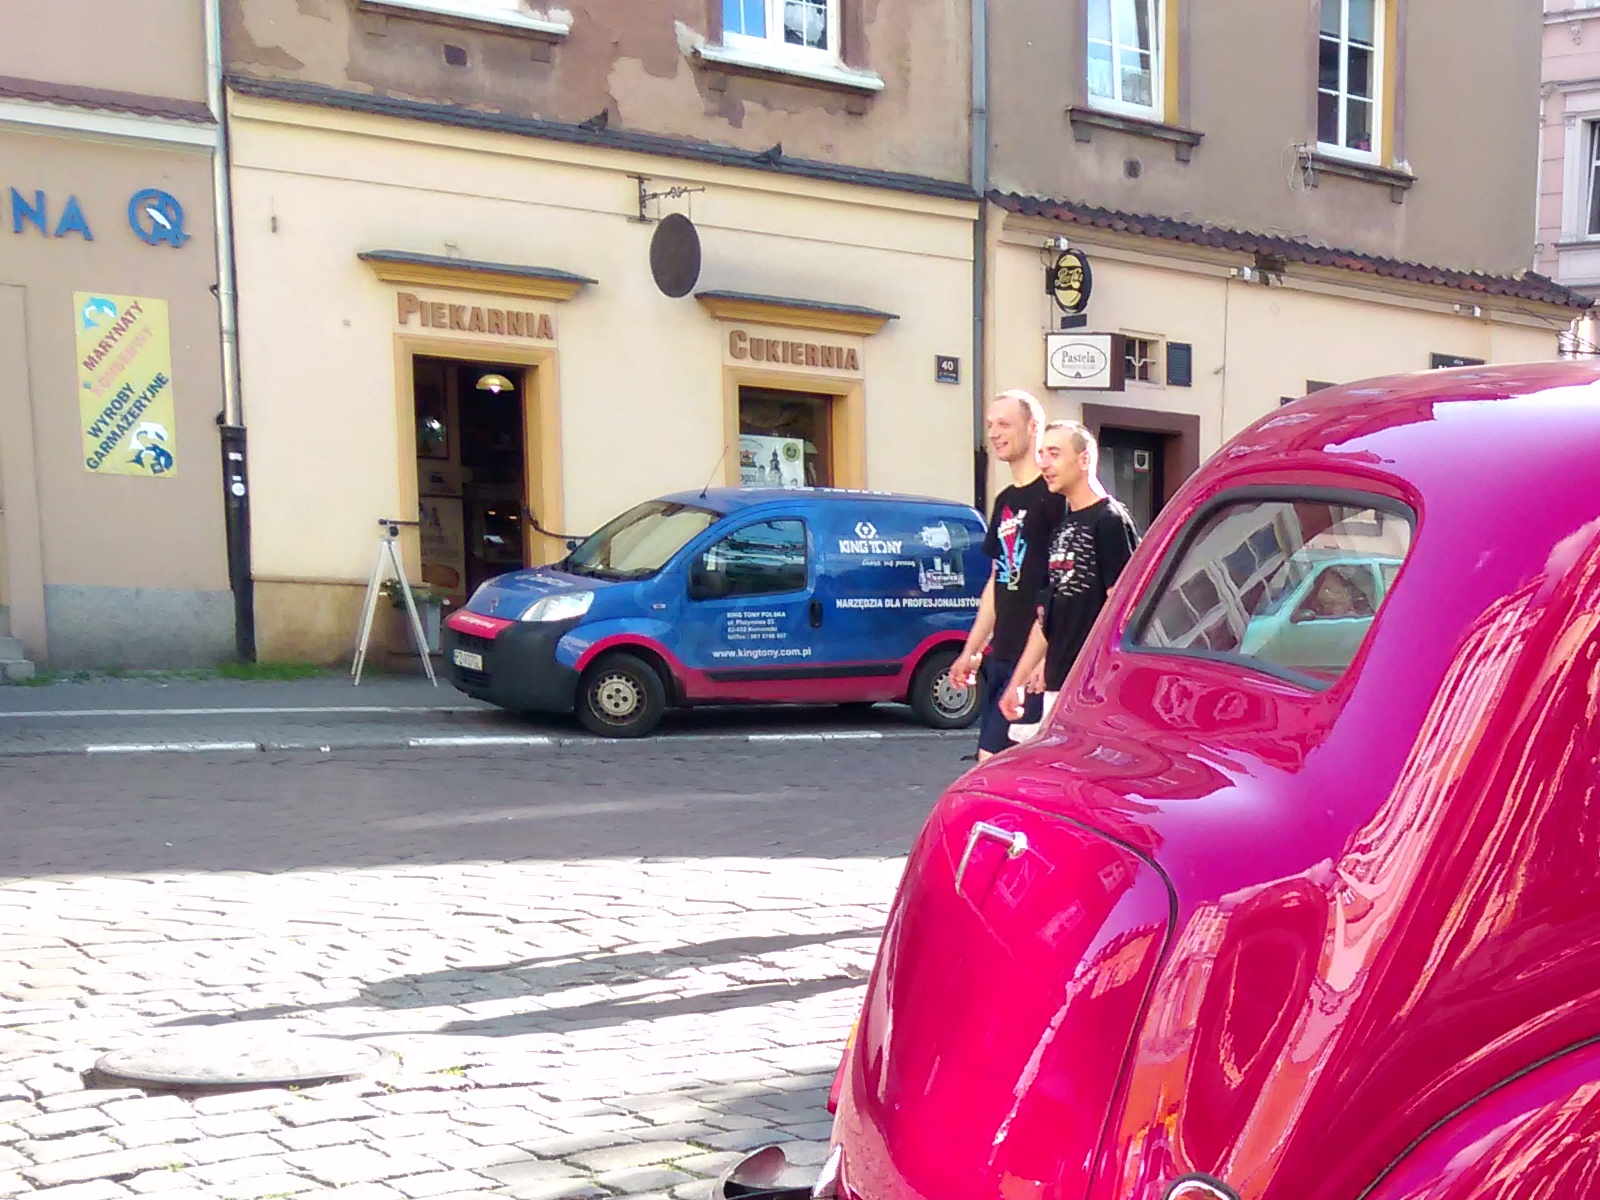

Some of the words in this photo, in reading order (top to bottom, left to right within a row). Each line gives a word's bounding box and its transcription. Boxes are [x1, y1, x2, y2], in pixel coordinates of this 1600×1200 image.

[396, 291, 554, 340] PIEKARNIA
[82, 301, 144, 371] MARYNATY
[729, 329, 860, 371] CUKIERNIA
[1061, 350, 1096, 363] Pastela
[941, 360, 954, 371] 40
[87, 382, 136, 439] WYROBY
[838, 540, 869, 553] KING
[870, 540, 903, 554] TONY
[836, 598, 883, 610] NARZĘDZIA
[885, 598, 900, 608] DLA
[712, 646, 812, 659] www.kingtony.com.pl
